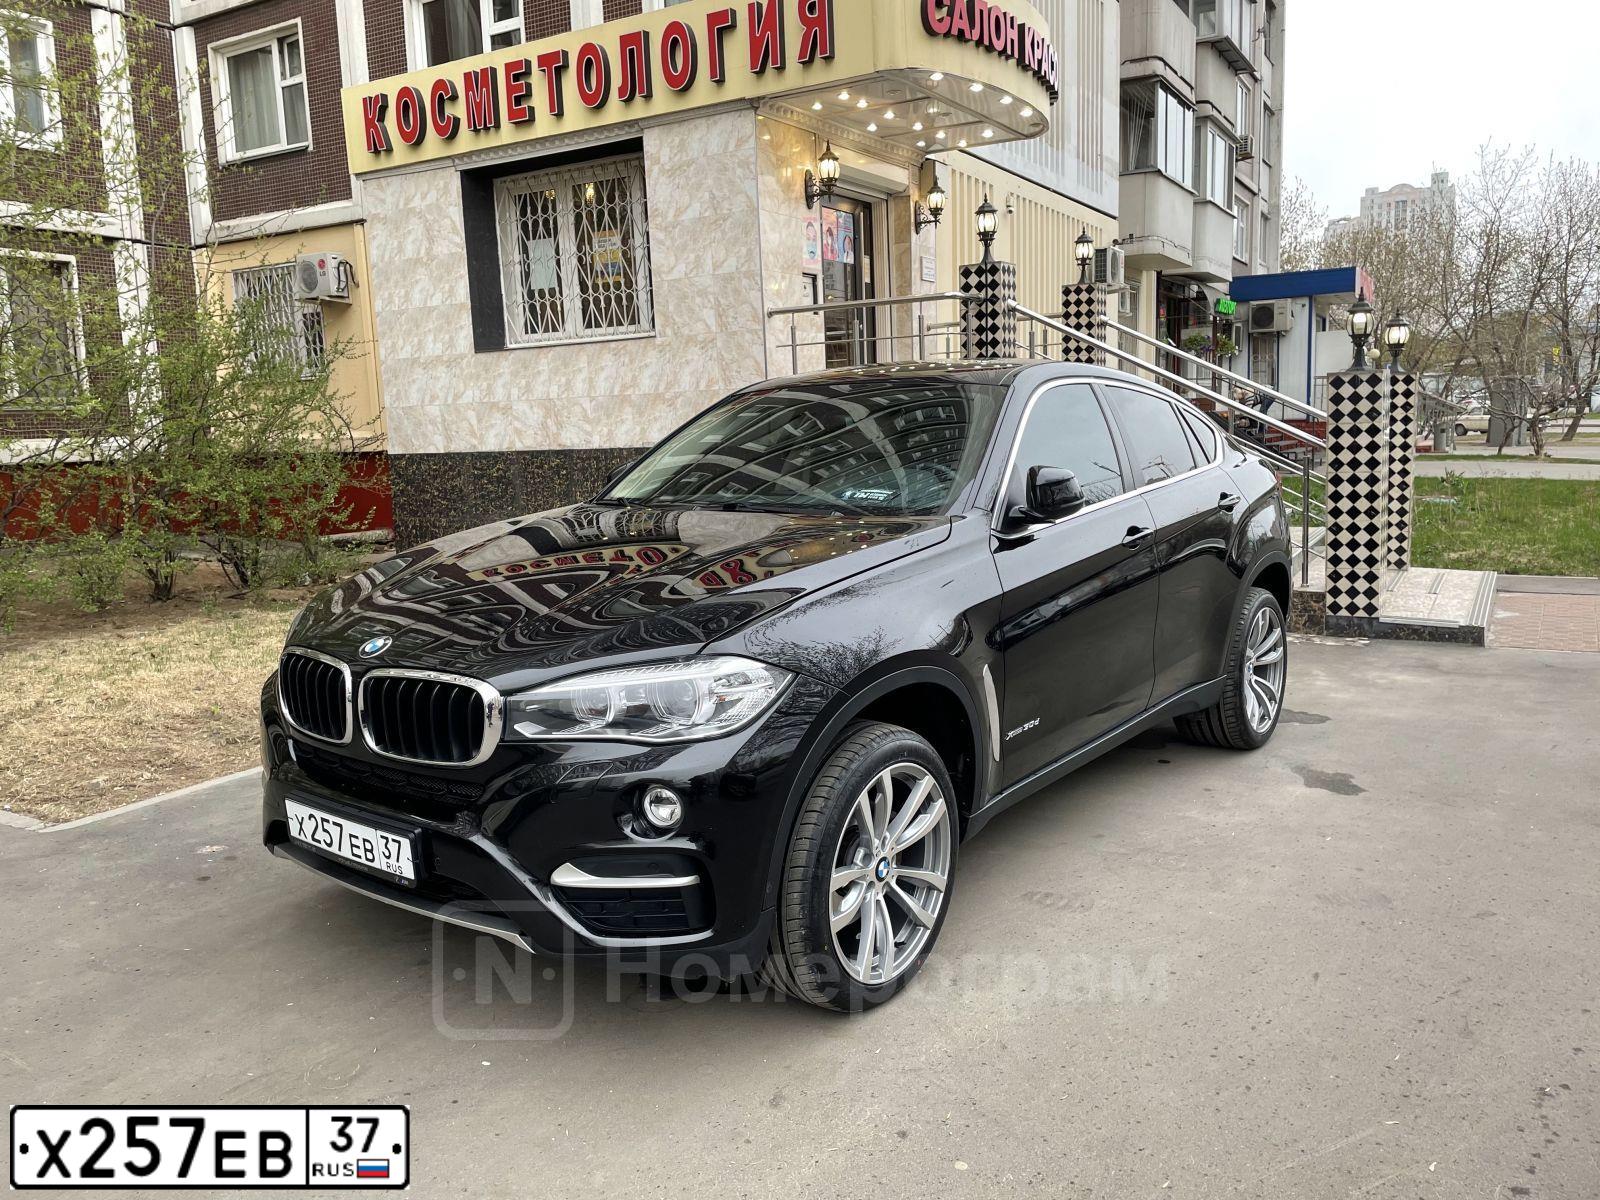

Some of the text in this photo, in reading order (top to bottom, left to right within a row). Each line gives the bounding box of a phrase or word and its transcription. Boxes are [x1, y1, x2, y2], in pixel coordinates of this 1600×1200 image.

[921, 0, 1018, 59] САЛОН
[362, 0, 834, 153] КОСМЕТОЛОГИЯ
[380, 834, 401, 863] 37
[386, 861, 403, 875] RUS
